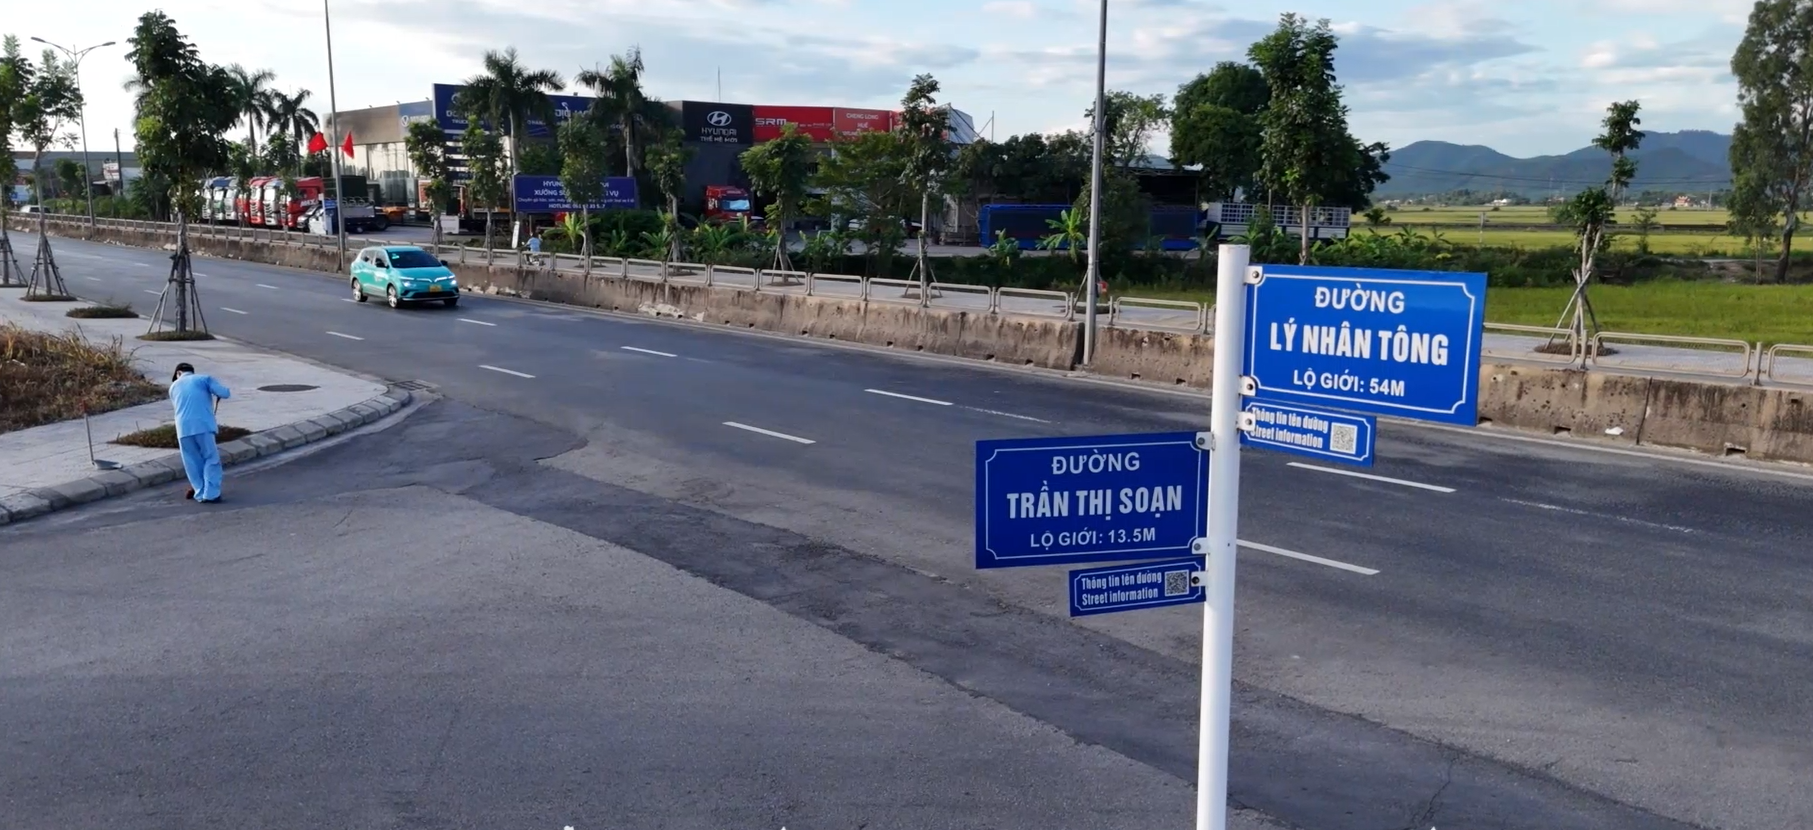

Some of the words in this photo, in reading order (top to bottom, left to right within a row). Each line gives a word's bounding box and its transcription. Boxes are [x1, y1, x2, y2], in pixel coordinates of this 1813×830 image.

[701, 127, 738, 136] HYUNDAI
[755, 117, 788, 127] SRM
[1315, 283, 1405, 314] ĐƯỜNG
[1270, 317, 1297, 352] LÝ
[1302, 321, 1372, 359] NHÂN
[1378, 325, 1449, 366] TÔNG
[1293, 367, 1316, 390] LỘ
[1320, 369, 1364, 392] GIỚI:
[1370, 378, 1405, 397] 54M
[1275, 411, 1288, 425] tin
[1288, 413, 1301, 427] tên
[1303, 415, 1329, 434] đường
[1275, 428, 1323, 449] information
[1051, 449, 1140, 475] ĐƯỜNG
[1007, 480, 1069, 519] TRẦN
[1076, 489, 1112, 520] THỊ
[1119, 485, 1182, 518] SOẠN
[1030, 530, 1054, 550] LỘ
[1058, 527, 1103, 546] GIỚI:
[1108, 527, 1156, 544] 13.5M
[1081, 576, 1107, 590] Thông
[1108, 574, 1120, 587] tin
[1121, 573, 1135, 586] tên
[1136, 570, 1162, 584] đường
[1081, 592, 1108, 606] Street
[1109, 586, 1159, 603] information
